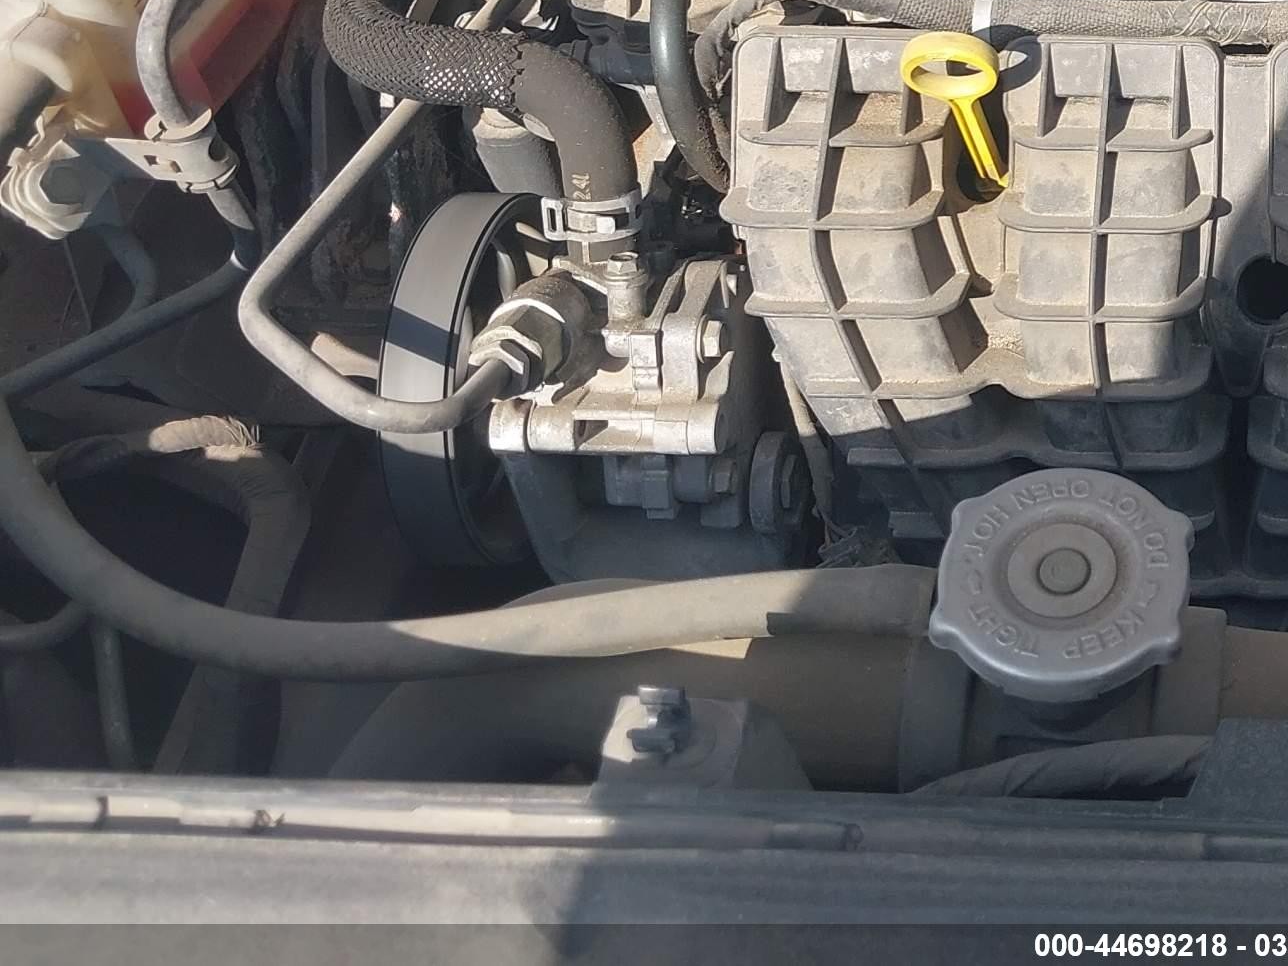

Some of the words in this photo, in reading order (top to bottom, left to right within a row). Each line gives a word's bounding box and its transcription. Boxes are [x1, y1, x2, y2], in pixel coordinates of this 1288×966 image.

[1013, 479, 1091, 512] OPEN
[1098, 495, 1153, 532] NOT
[963, 504, 1011, 558] HOT
[1143, 531, 1170, 568] DO
[968, 605, 1041, 659] TIGHT
[1063, 609, 1146, 659] KEEP
